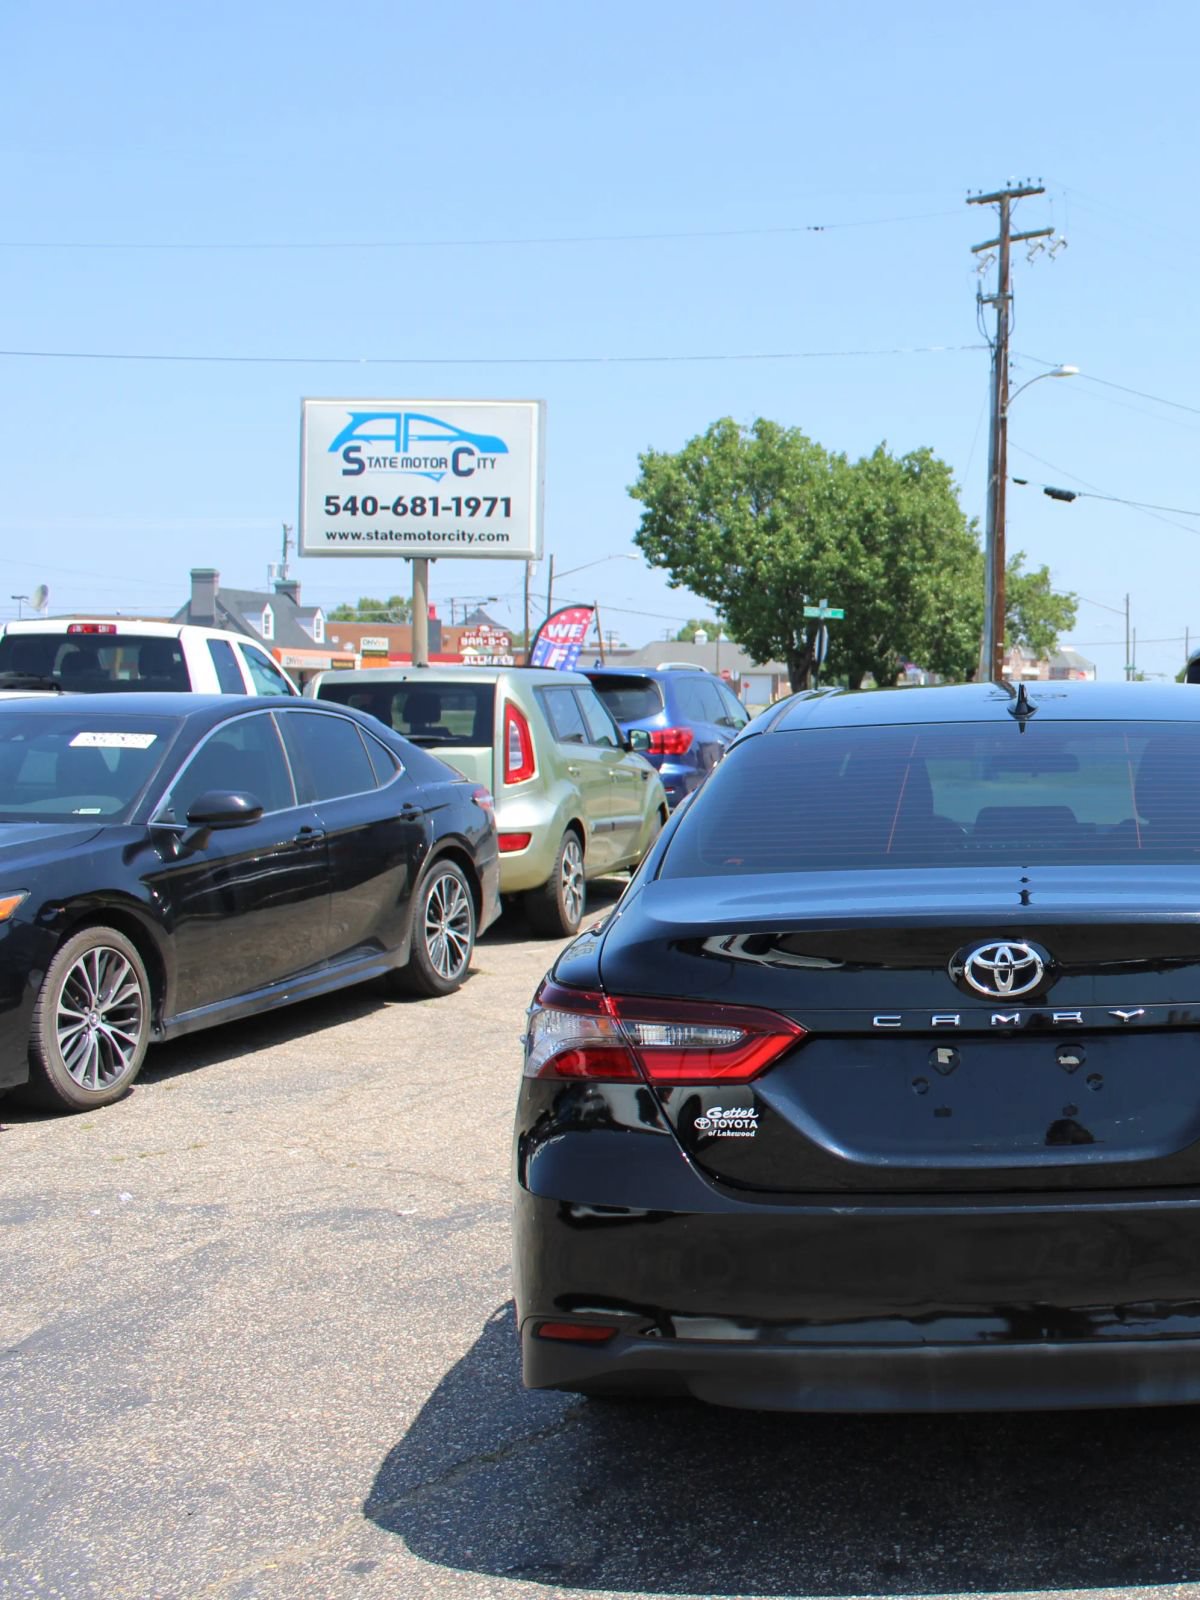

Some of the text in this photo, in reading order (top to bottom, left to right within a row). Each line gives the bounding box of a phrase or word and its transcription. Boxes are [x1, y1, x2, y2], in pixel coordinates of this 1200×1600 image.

[401, 456, 448, 469] MOTOR
[324, 495, 511, 518] 540-681-1971
[325, 530, 510, 544] www.statemotorcity.com
[547, 623, 584, 638] WE
[873, 1009, 1145, 1026] CAMRY
[706, 1106, 759, 1119] Gettel
[711, 1119, 758, 1129] TOYOTA
[707, 1129, 755, 1137] of Lakewood
